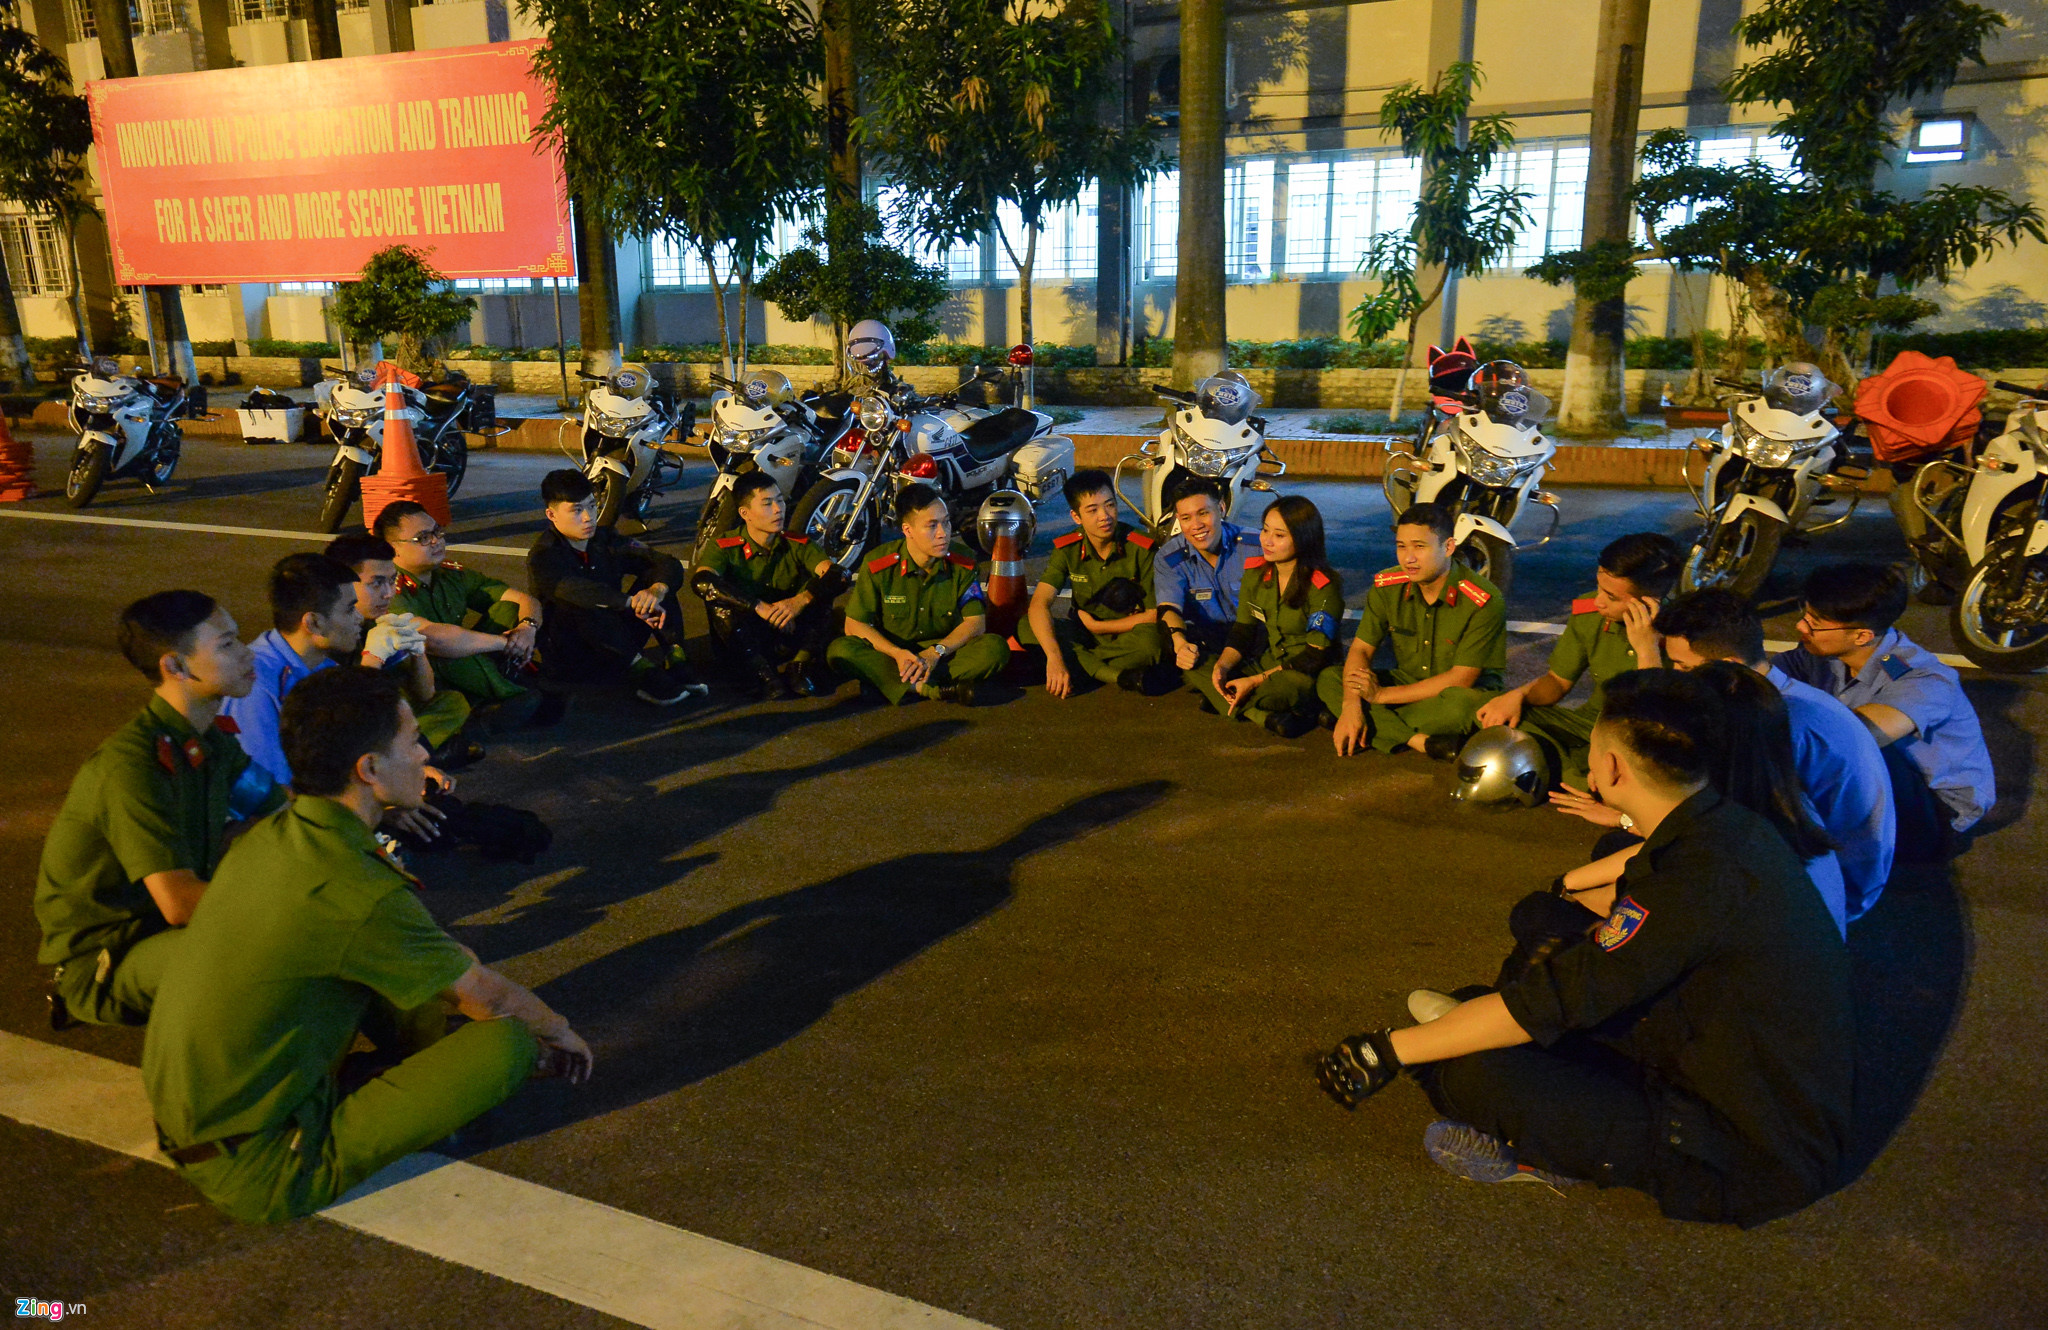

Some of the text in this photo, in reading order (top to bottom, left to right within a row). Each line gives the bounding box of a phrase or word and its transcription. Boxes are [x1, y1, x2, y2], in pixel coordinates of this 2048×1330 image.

[115, 91, 531, 168] INNOVATION IN POLICE EDUCATION AND TRAINING
[154, 182, 505, 243] FOR A SAFER AND MORE SECURE VIETNAM
